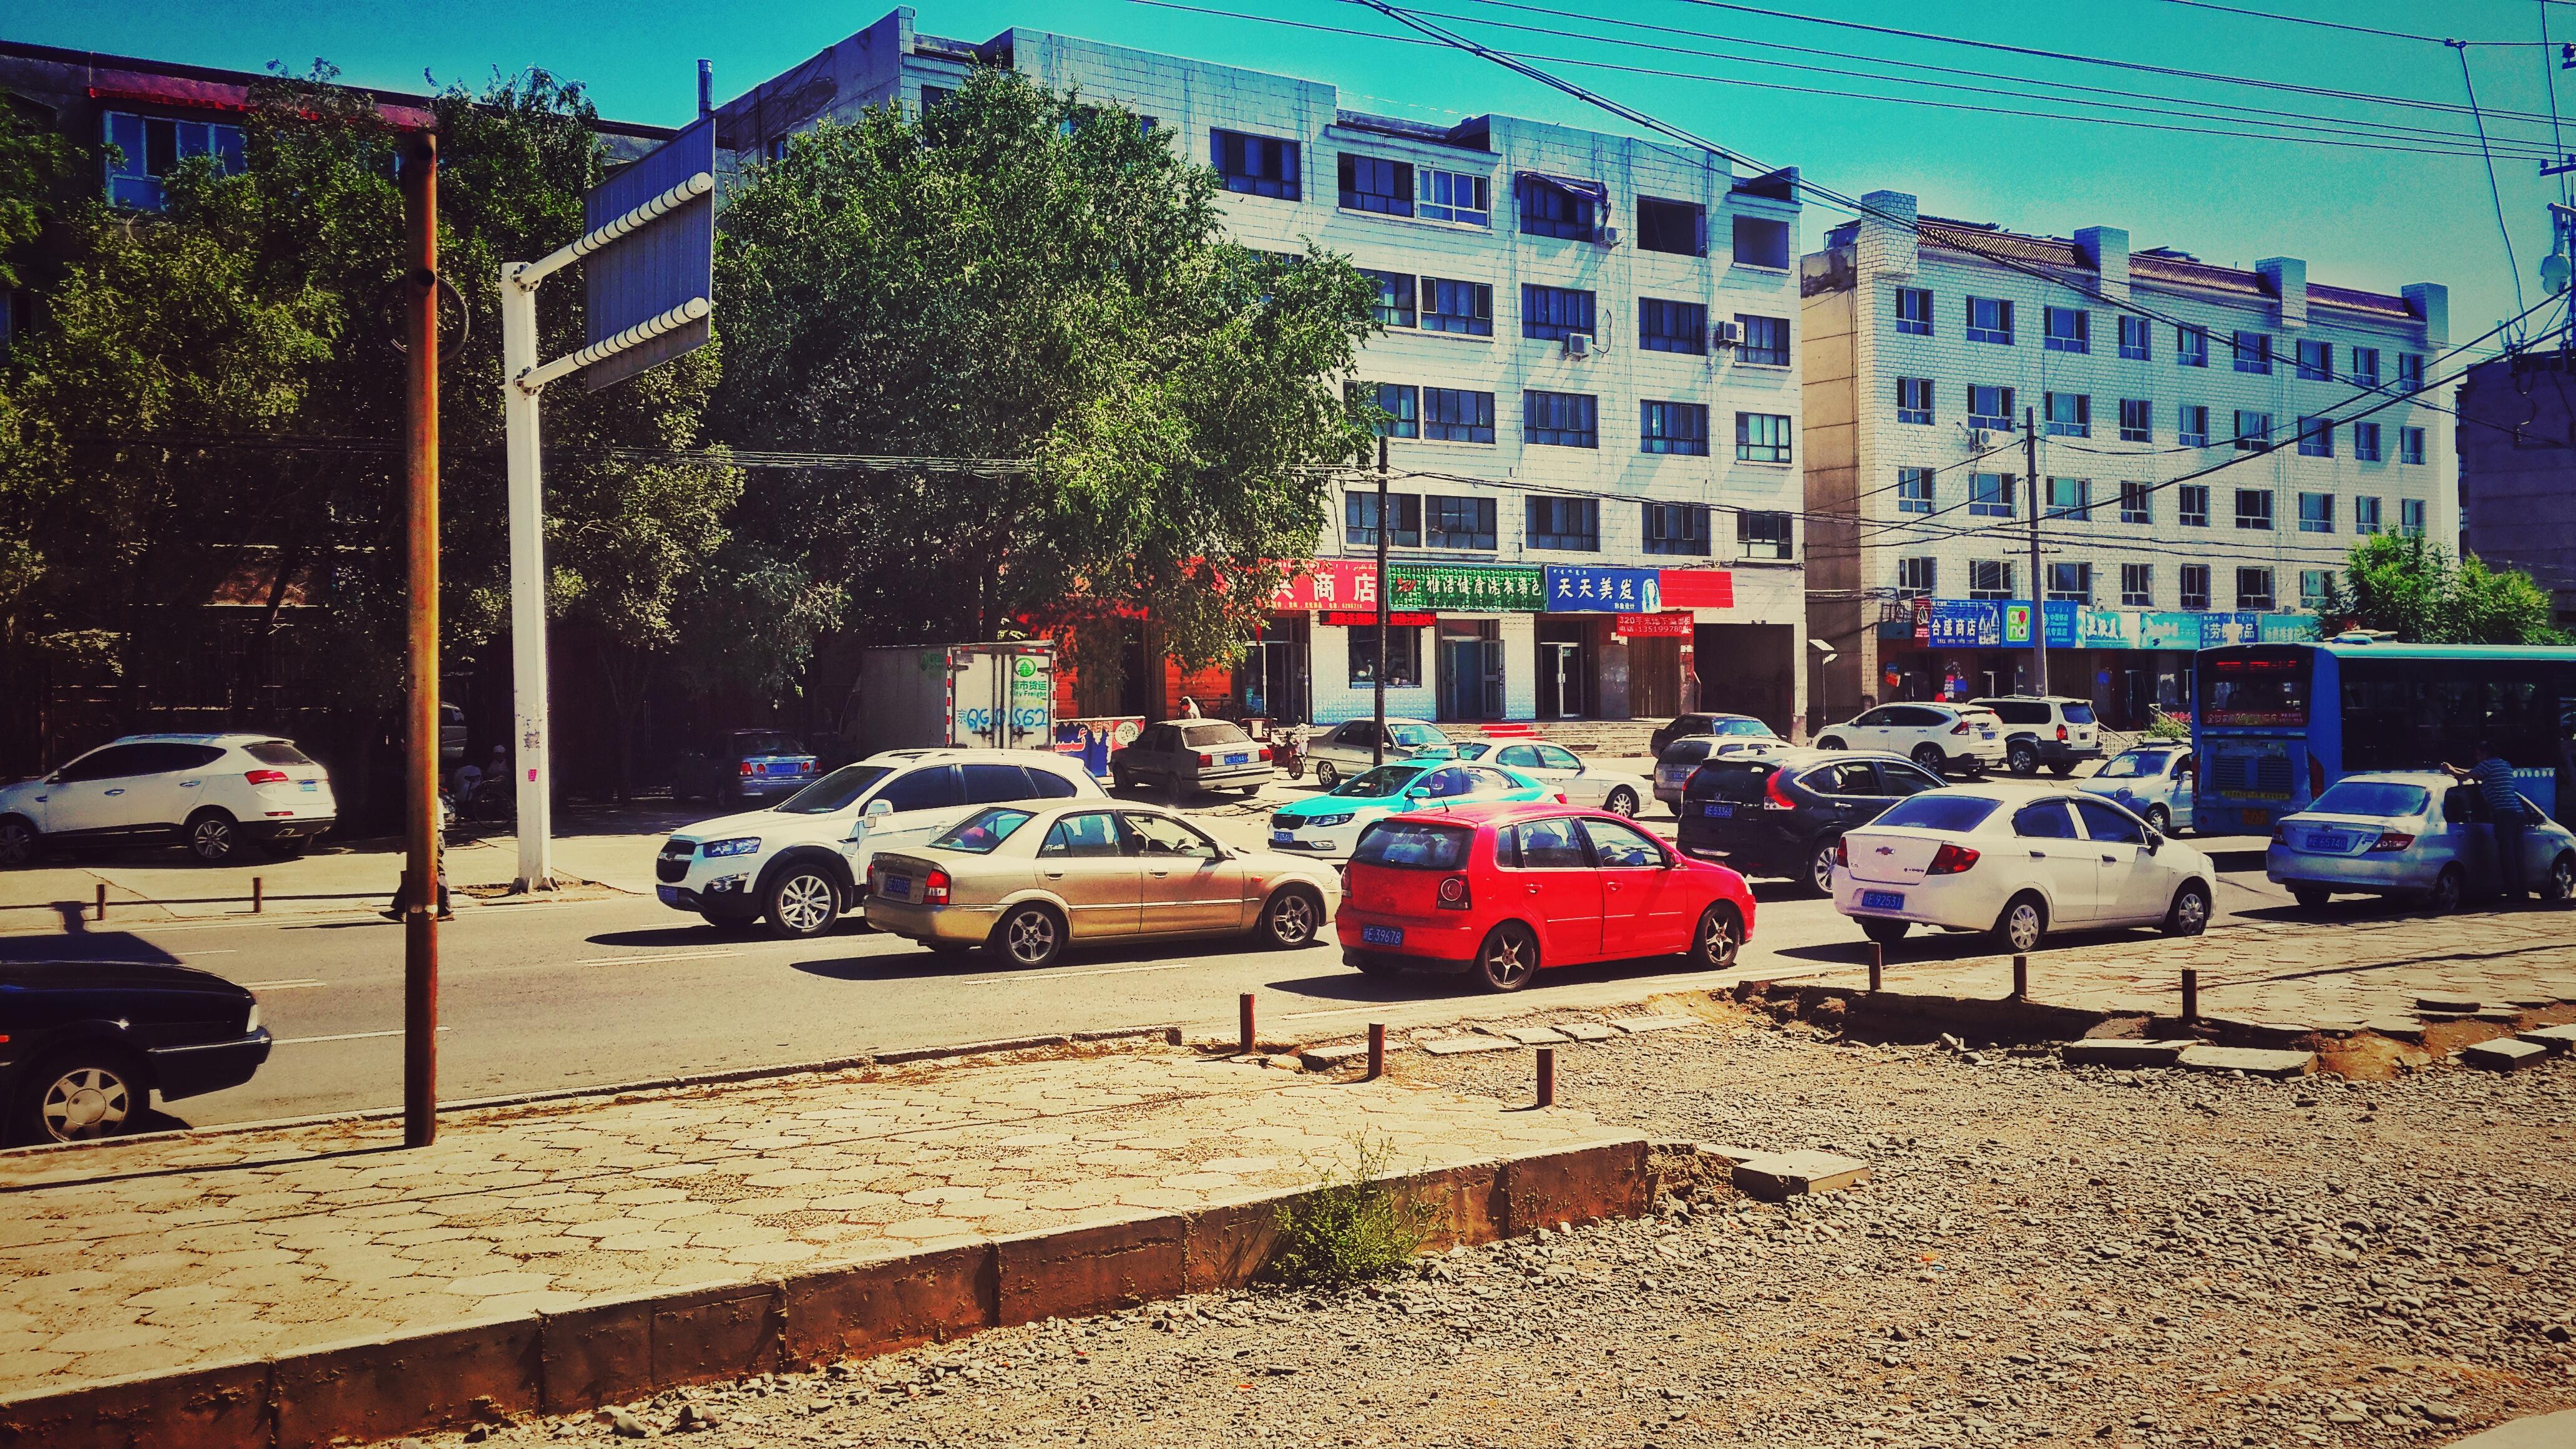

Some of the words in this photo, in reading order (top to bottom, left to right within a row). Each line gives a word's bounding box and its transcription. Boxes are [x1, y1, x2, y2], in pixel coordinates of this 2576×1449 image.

[1557, 577, 1635, 601] 天天美发
[1931, 618, 1976, 636] 合盛商店
[2210, 623, 2255, 639] 劳品
